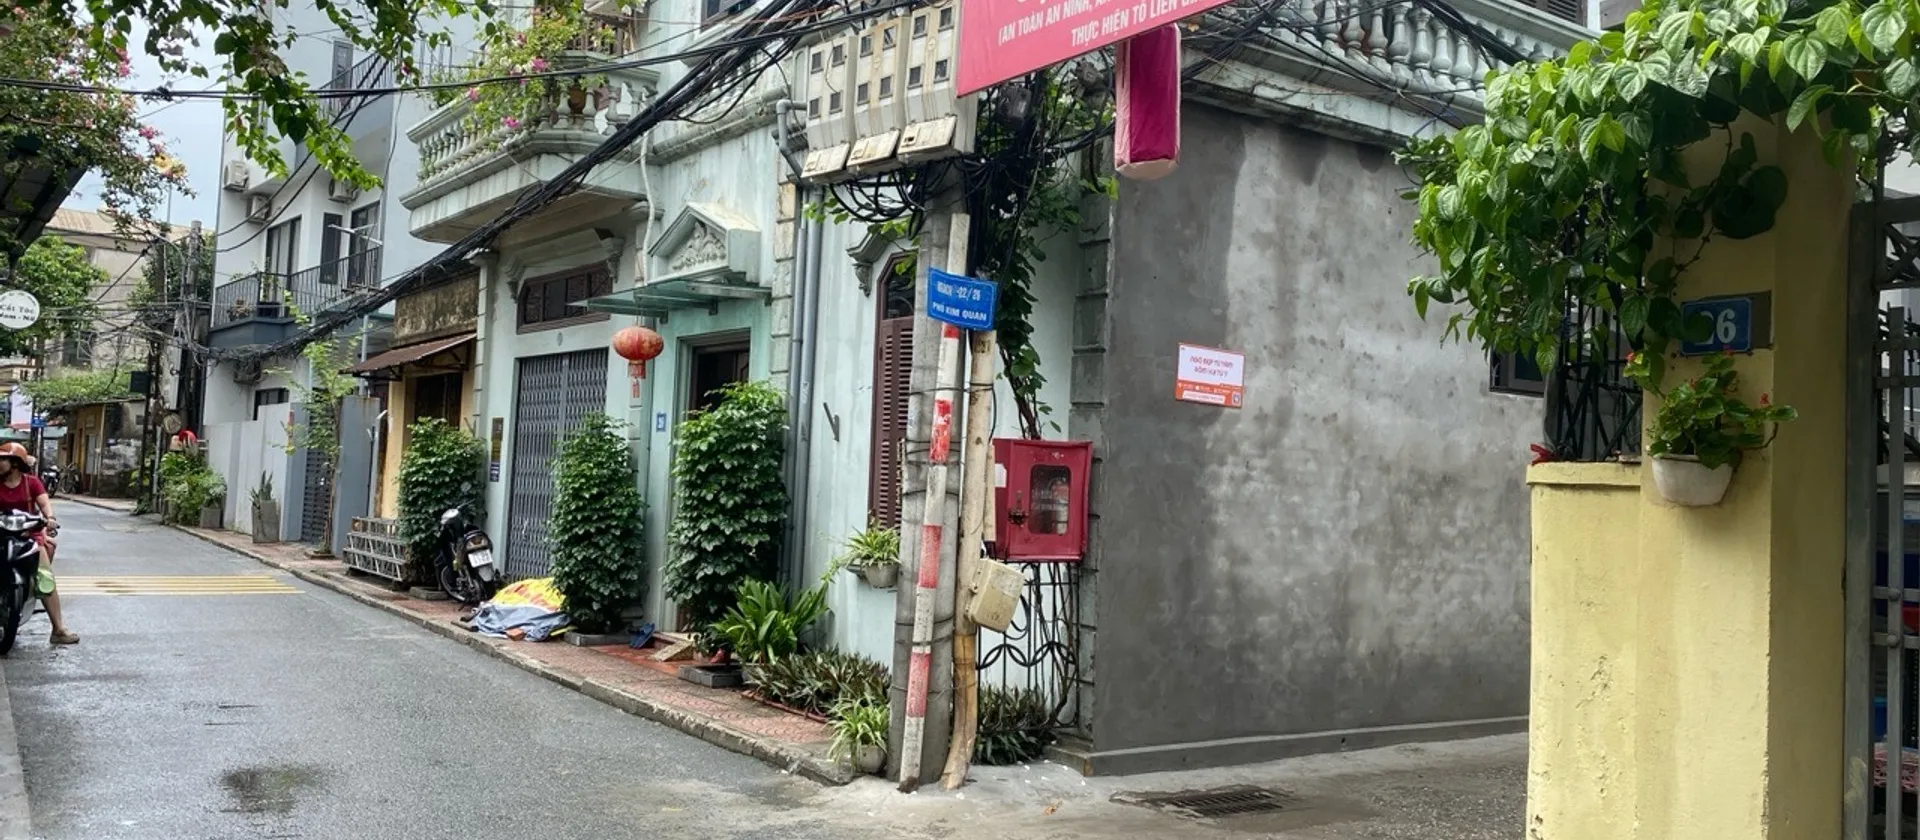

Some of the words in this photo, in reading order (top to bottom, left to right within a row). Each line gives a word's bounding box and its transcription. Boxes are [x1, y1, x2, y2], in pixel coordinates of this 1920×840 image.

[998, 22, 1016, 46] (AN
[1018, 11, 1044, 36] TOÀN
[1045, 3, 1061, 26] AN
[1071, 20, 1099, 47] THỰC
[1101, 8, 1130, 36] HIỆN
[946, 307, 960, 317] KIM
[962, 309, 987, 321] QUAN
